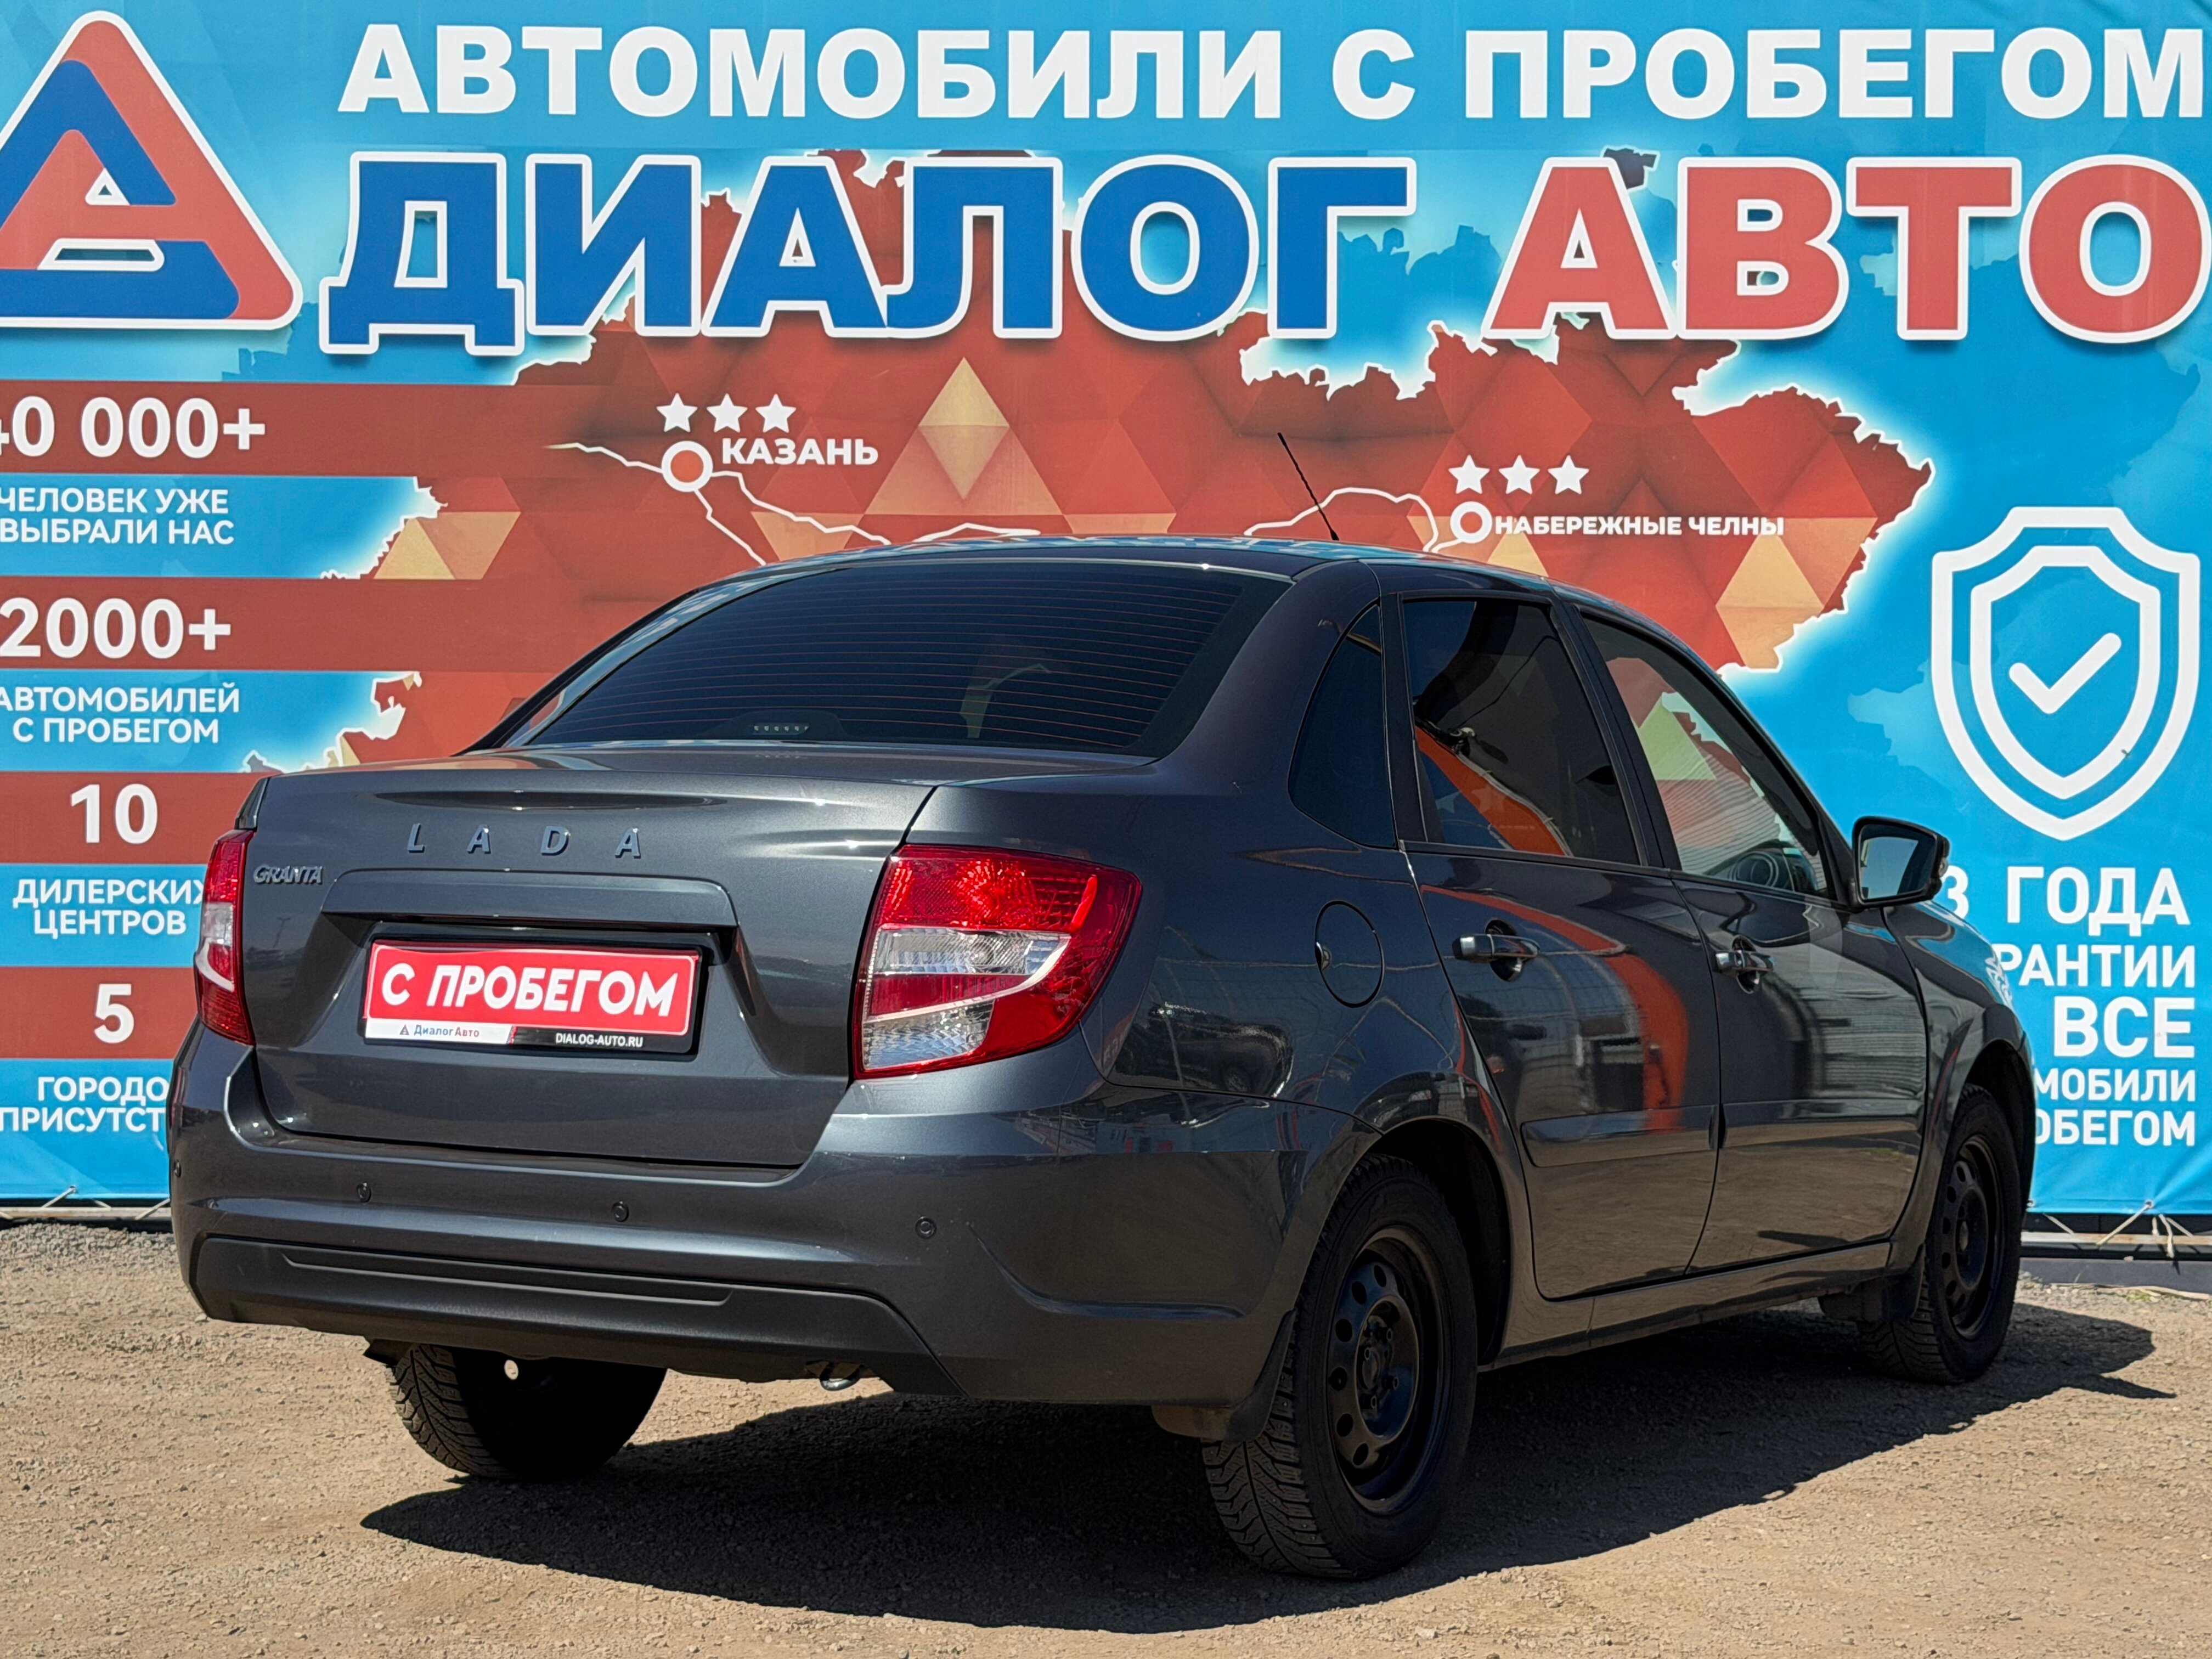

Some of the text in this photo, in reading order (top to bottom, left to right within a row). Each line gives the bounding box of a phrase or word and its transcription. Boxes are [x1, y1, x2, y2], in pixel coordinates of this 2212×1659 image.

[337, 24, 2204, 120] АВТОМОБИЛИ С ПРОБЕГОМ
[319, 151, 2212, 356] ДИАЛОГ АВТО
[721, 437, 879, 466] КАЗАНЬ
[0, 487, 229, 514] ЧЕЛОВЕК УЖЕ
[0, 517, 235, 545] ВЫБРАЛИ НАС
[1495, 515, 1785, 536] НАБЕРЕЖНЫЕ ЧЕЛНЫ
[0, 597, 232, 659] 2000+
[13, 716, 219, 743] С ПРОБЕГОМ
[71, 783, 158, 844] 10
[407, 822, 642, 859] LADA
[253, 864, 324, 885] GRANTA
[2007, 865, 2191, 937] ГОДА
[34, 909, 187, 940] ЦЕНТРОВ
[381, 962, 679, 1017] С ПРОБЕГОМ
[94, 983, 135, 1044] 5
[2053, 995, 2195, 1058] ВСЕ
[555, 1032, 644, 1048] DIALOG-AUTO.RU
